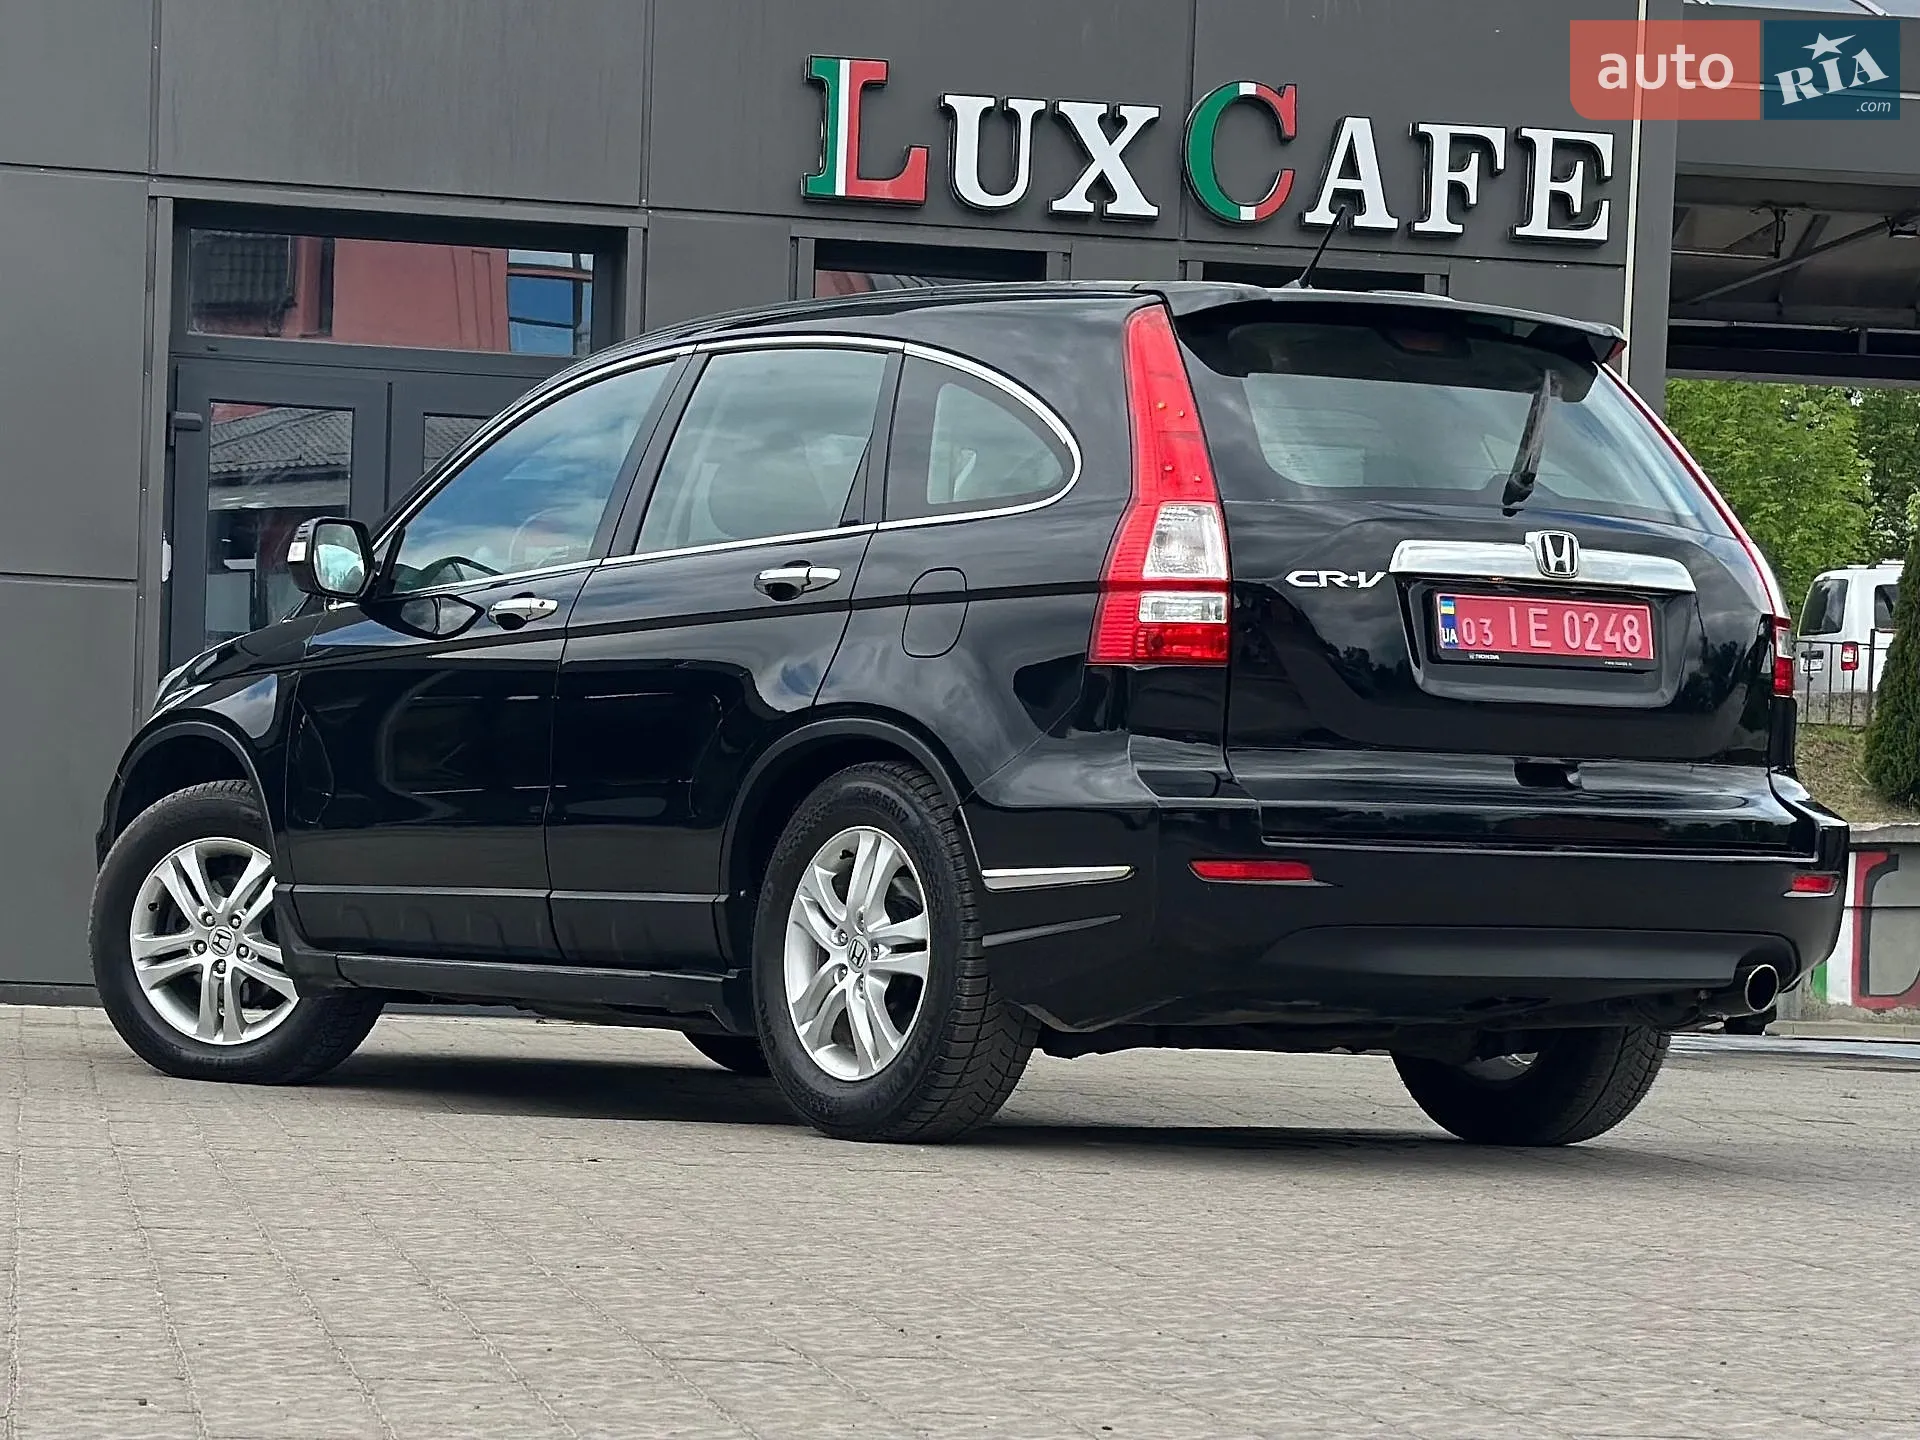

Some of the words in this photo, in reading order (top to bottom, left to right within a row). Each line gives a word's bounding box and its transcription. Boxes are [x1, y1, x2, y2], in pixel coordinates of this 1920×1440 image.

[1284, 569, 1387, 590] CR-V
[1441, 627, 1459, 644] UA
[1461, 616, 1494, 646] 03
[1562, 609, 1643, 654] 0248
